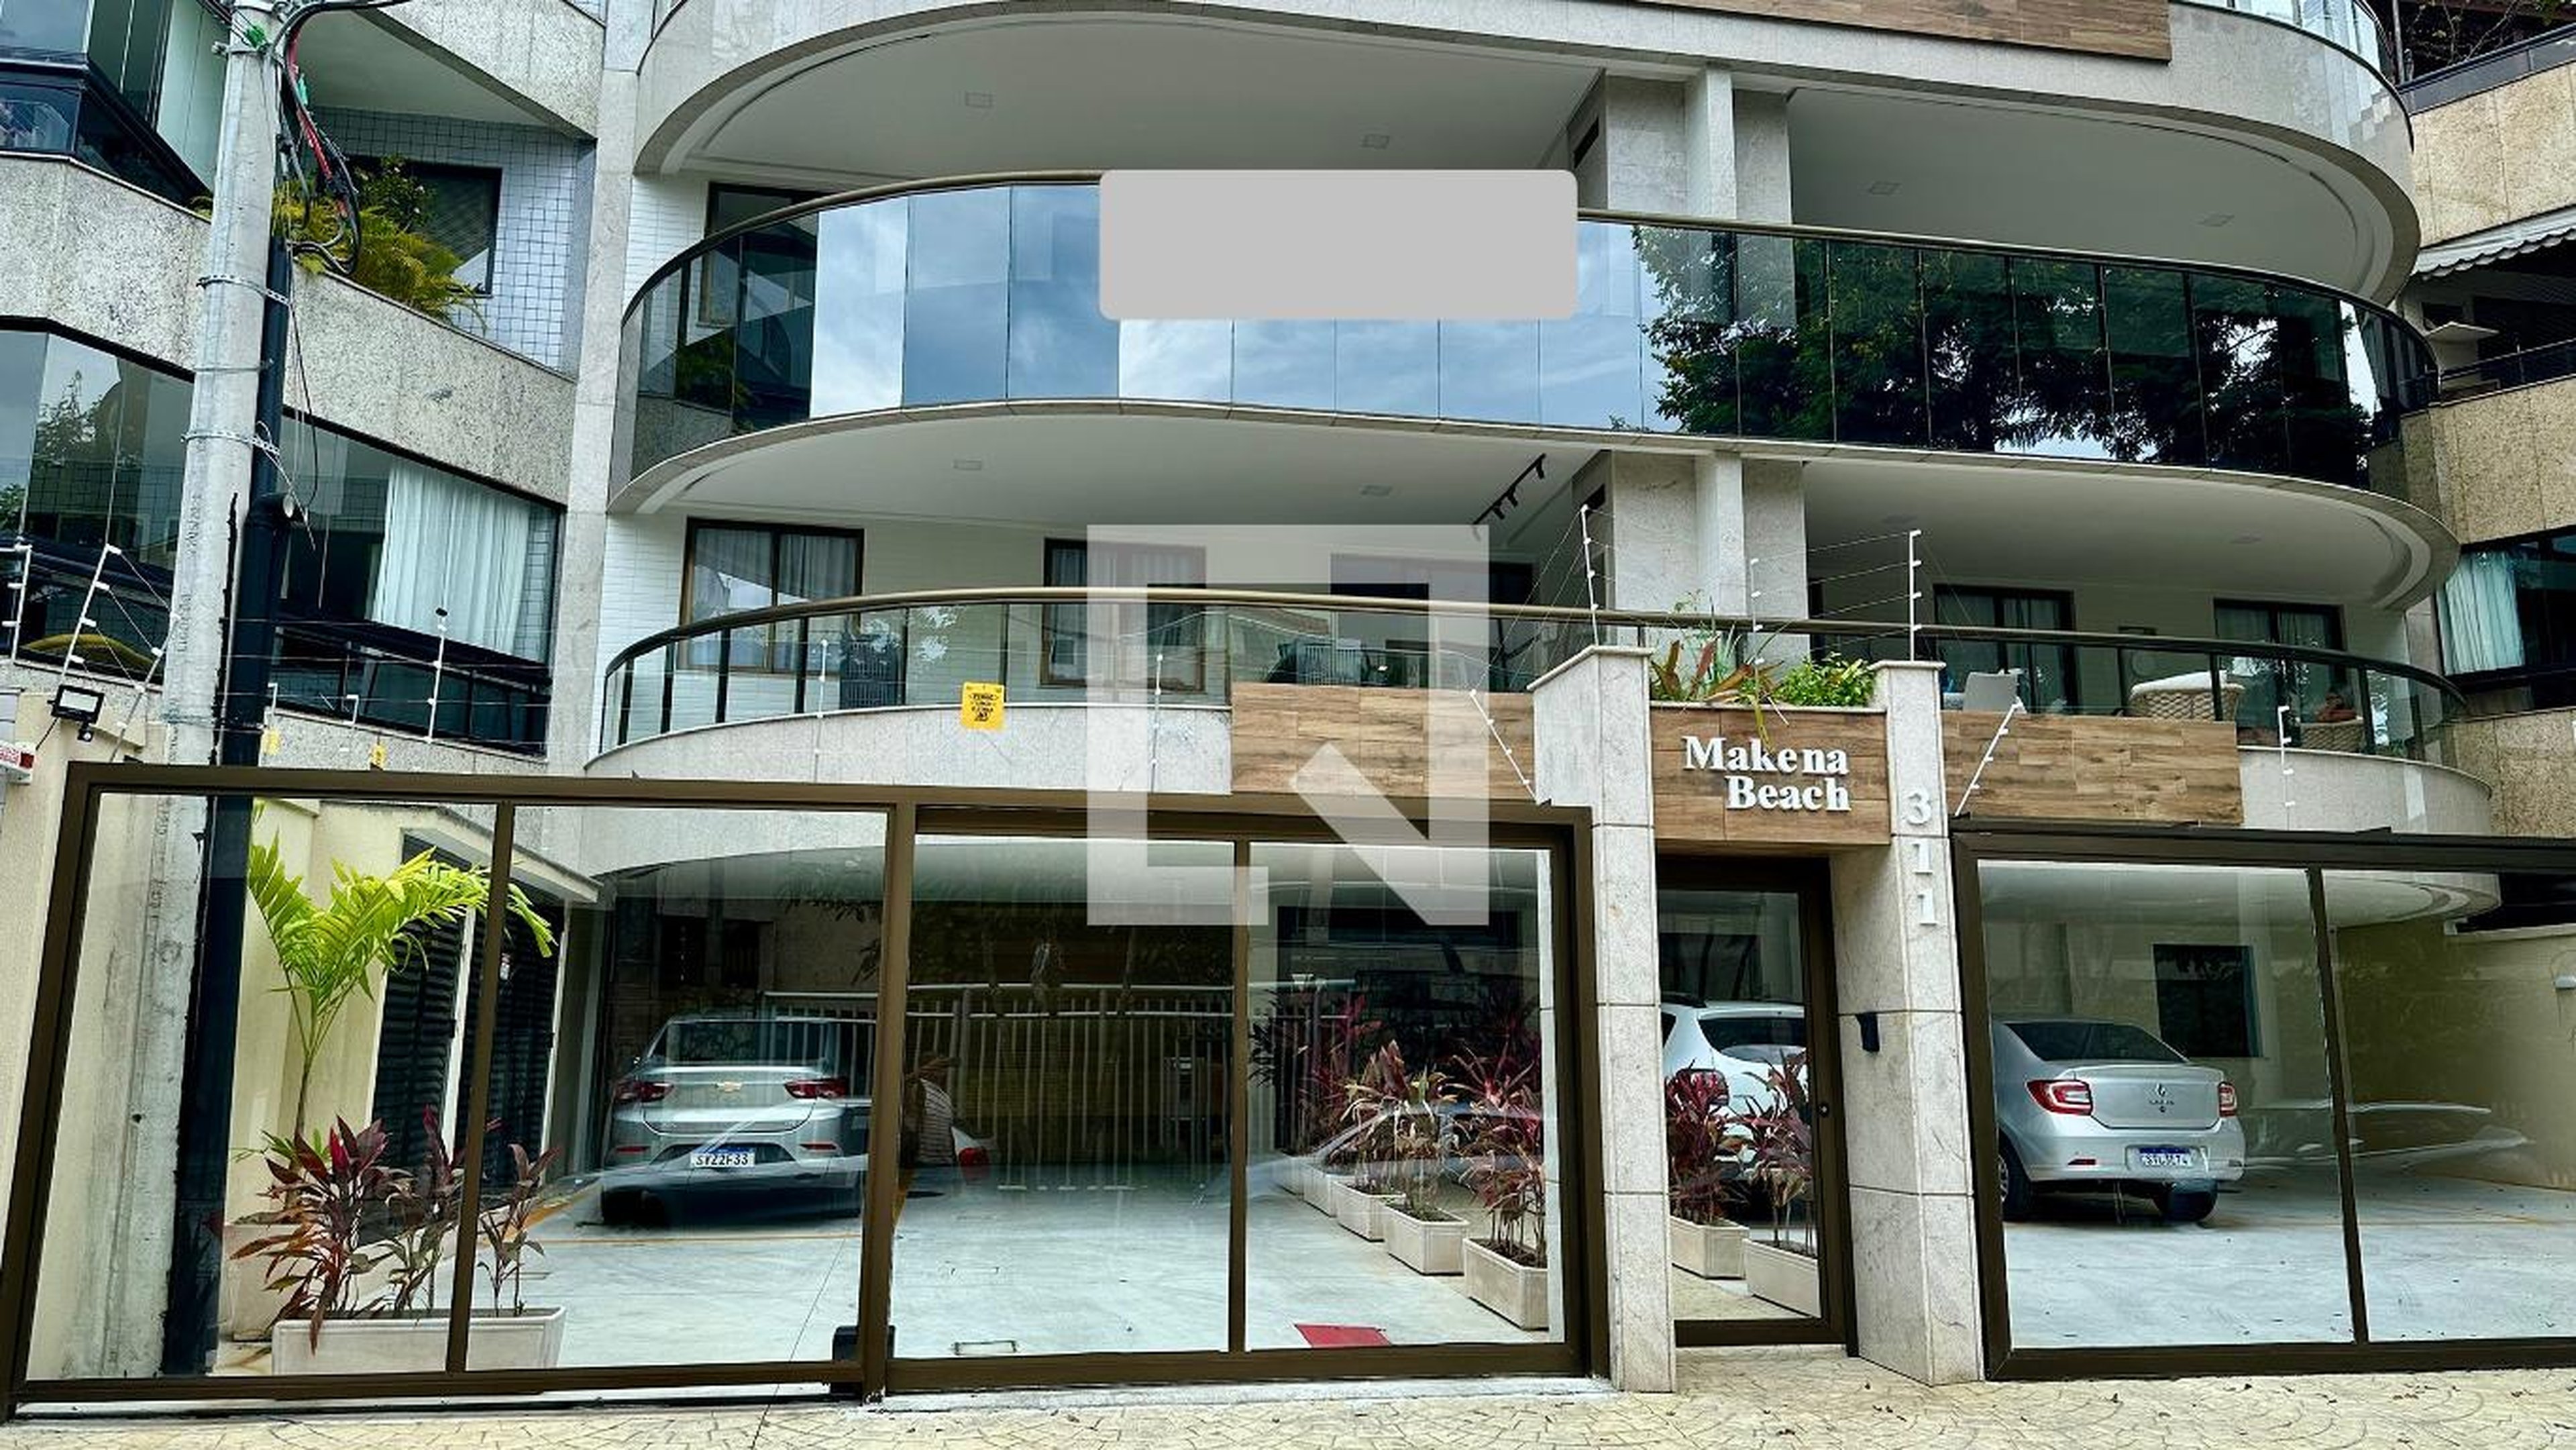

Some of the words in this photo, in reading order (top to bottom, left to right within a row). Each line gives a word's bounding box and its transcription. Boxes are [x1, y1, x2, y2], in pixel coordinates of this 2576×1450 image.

[1682, 735, 1850, 775] Makena
[1725, 775, 1851, 812] Beach
[1907, 788, 1937, 925] 311
